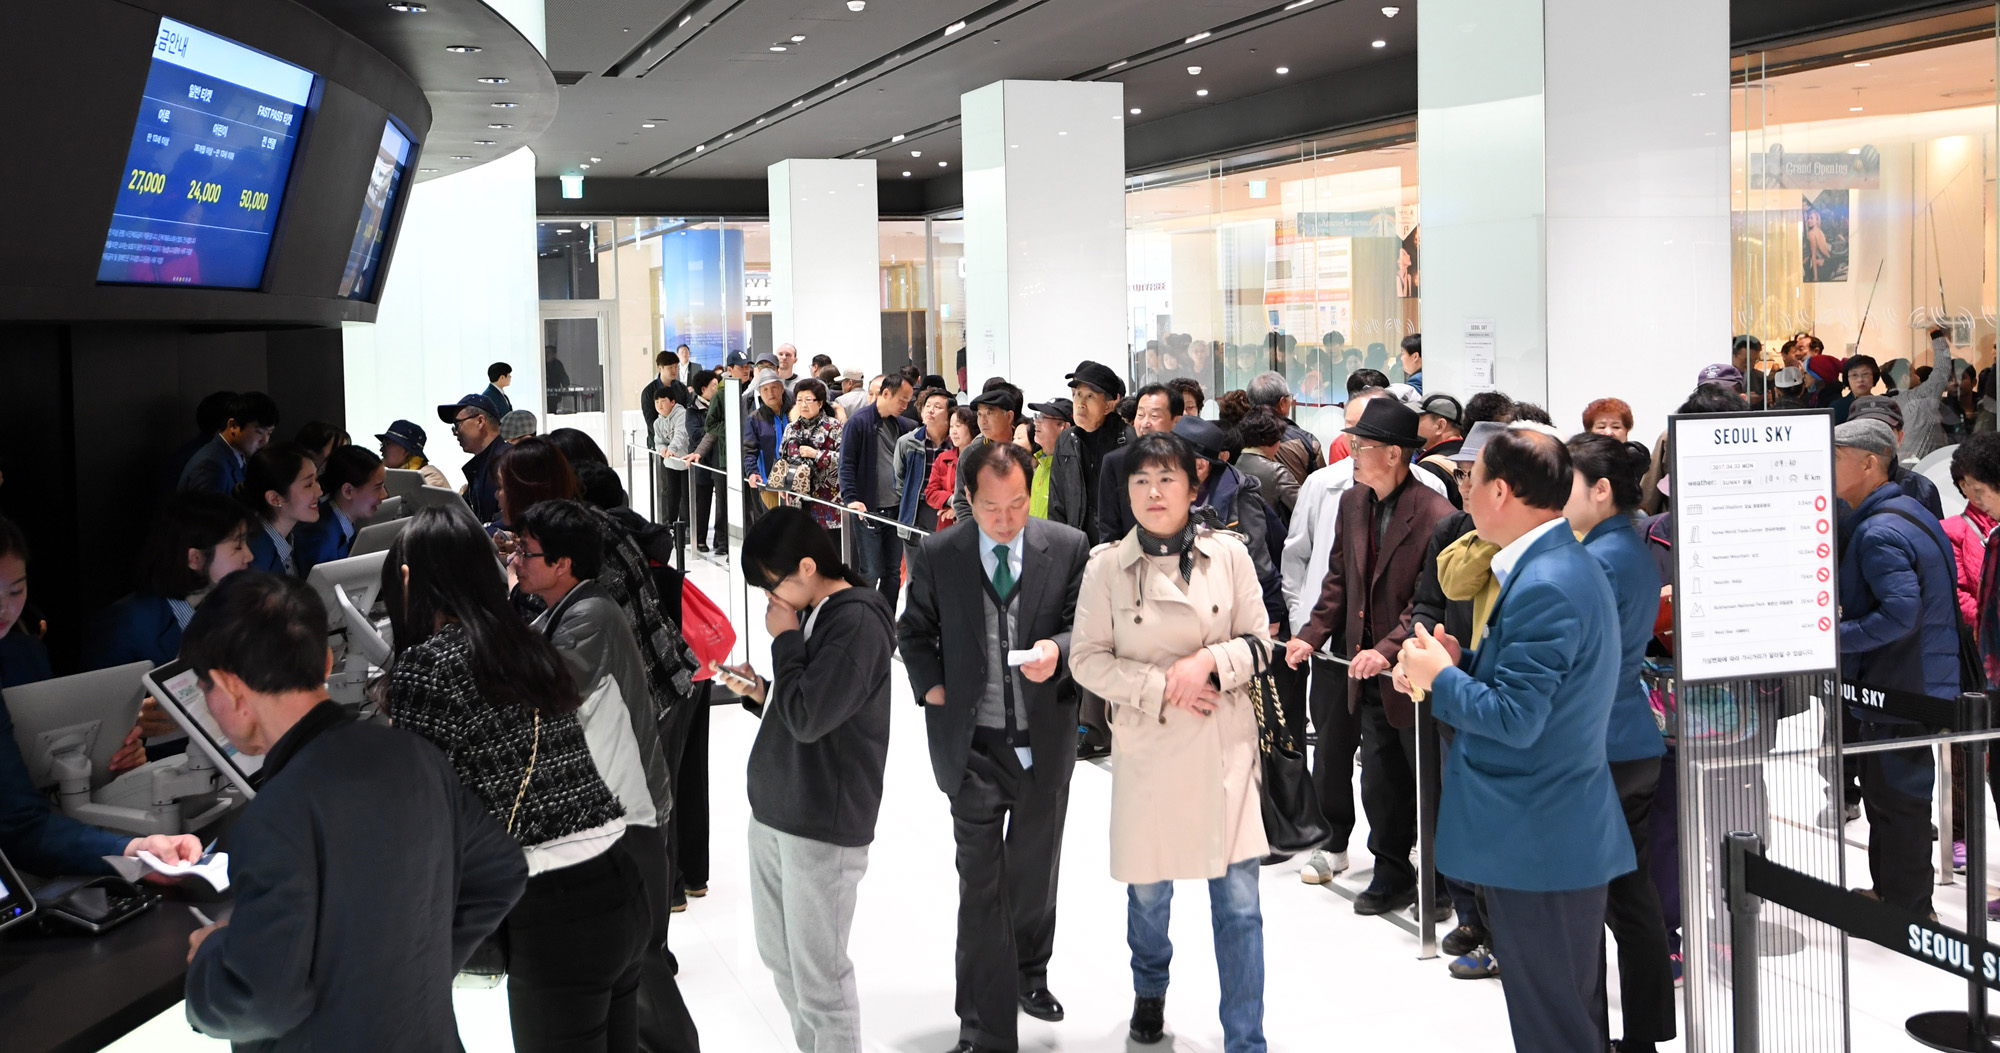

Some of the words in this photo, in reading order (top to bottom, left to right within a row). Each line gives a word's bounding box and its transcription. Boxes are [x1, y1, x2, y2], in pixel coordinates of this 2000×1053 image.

[155, 28, 189, 58] 금안내
[201, 88, 213, 103] 티켓
[257, 104, 271, 119] FAST
[270, 109, 284, 122] PASS
[283, 113, 293, 126] 티켓
[212, 123, 229, 138] 어린이
[1785, 162, 1812, 176] Grand
[1813, 161, 1848, 176] Opening
[128, 169, 167, 195] 27,000
[187, 180, 222, 204] 24,000
[239, 189, 269, 212] 50,000
[1714, 427, 1758, 445] SEOUL
[1765, 425, 1793, 442] SKY
[1687, 479, 1716, 487] weather:
[1823, 679, 1858, 702] SUL
[1861, 687, 1886, 708] SKY
[1908, 923, 1976, 973] SEOUL
